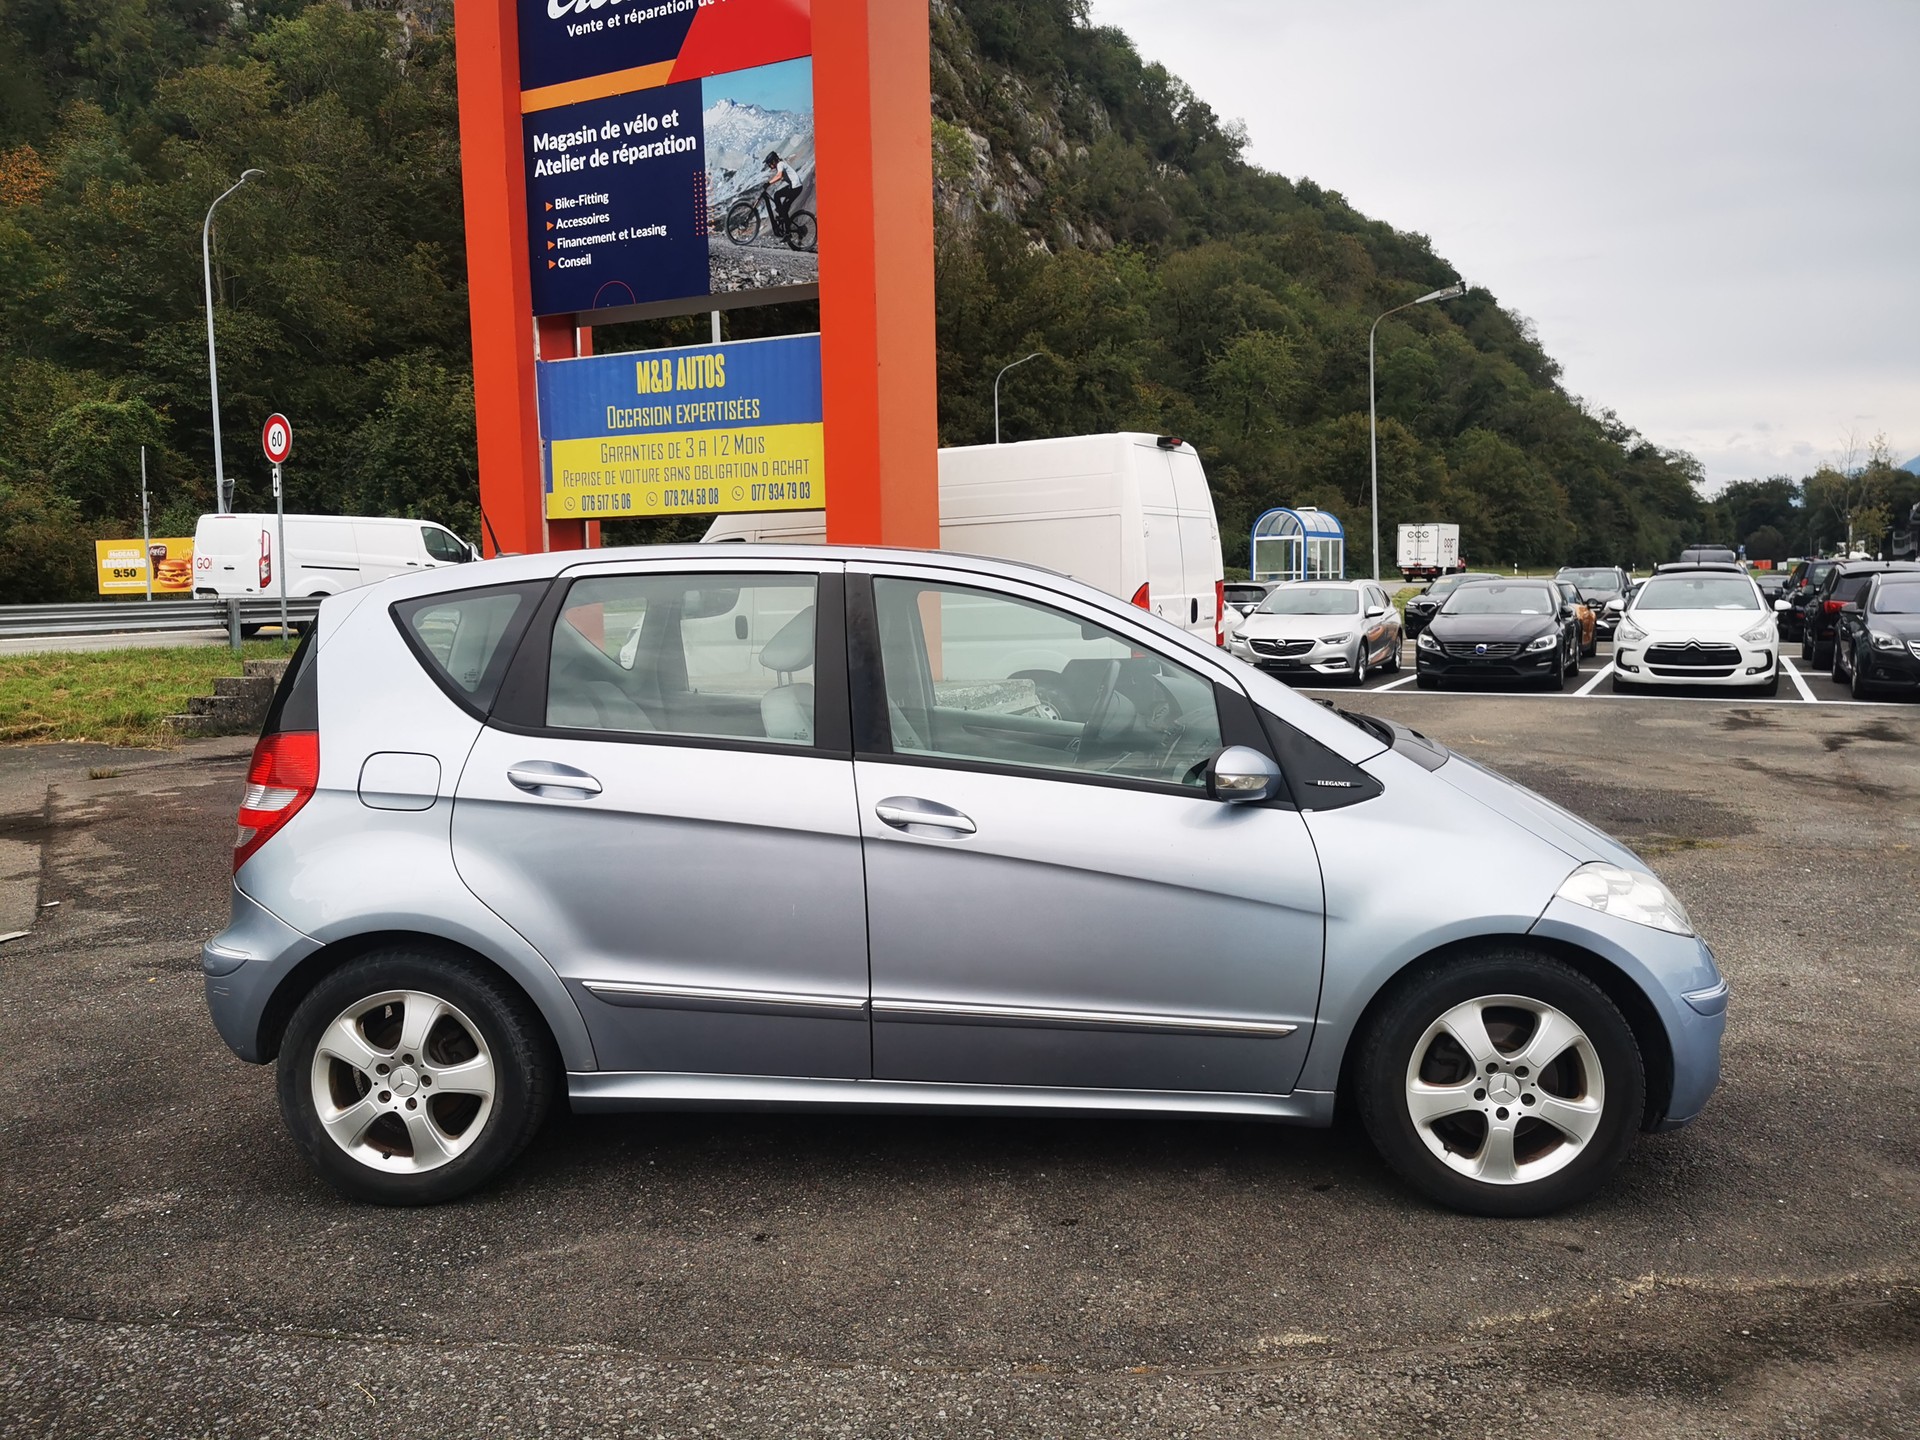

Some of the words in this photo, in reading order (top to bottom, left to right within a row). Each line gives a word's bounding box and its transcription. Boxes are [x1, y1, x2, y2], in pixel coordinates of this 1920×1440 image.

[567, 20, 603, 37] Vente
[607, 14, 620, 28] et
[624, 0, 694, 24] réparation
[533, 125, 597, 153] Magasin
[600, 120, 620, 140] de
[623, 113, 659, 136] vélo
[662, 109, 679, 128] et
[534, 153, 586, 178] Atelier
[589, 148, 609, 168] de
[612, 134, 697, 165] réparation
[555, 192, 609, 210] Bike-Fitting
[556, 213, 610, 230] Accessoires
[557, 230, 616, 250] Financement
[618, 229, 629, 241] et
[631, 224, 667, 239] Leasing
[558, 253, 592, 269] Conseil
[636, 359, 673, 395] M&B
[676, 353, 726, 391] AUTOS
[607, 405, 672, 430] OCCASION
[676, 396, 760, 424] EXPERTISÉES
[271, 430, 283, 448] 60
[601, 443, 664, 464] GARANTIES
[668, 441, 681, 459] DE
[686, 437, 694, 458] 3
[734, 433, 765, 455] MOIS
[563, 469, 601, 488] REPRISE
[605, 470, 616, 485] DE
[619, 467, 660, 485] VOITURE
[664, 465, 690, 482] SANS
[694, 461, 758, 481] OBLIGATION
[581, 494, 595, 512] 076
[597, 493, 609, 511] 517
[611, 493, 619, 510] 15
[621, 492, 631, 510] 06
[664, 489, 679, 507] 078
[681, 488, 694, 506] 214
[696, 487, 706, 505] 58
[708, 486, 719, 505] 08
[751, 483, 766, 501] 077
[768, 482, 784, 501] 934
[786, 481, 797, 500] 79
[799, 480, 811, 499] 03
